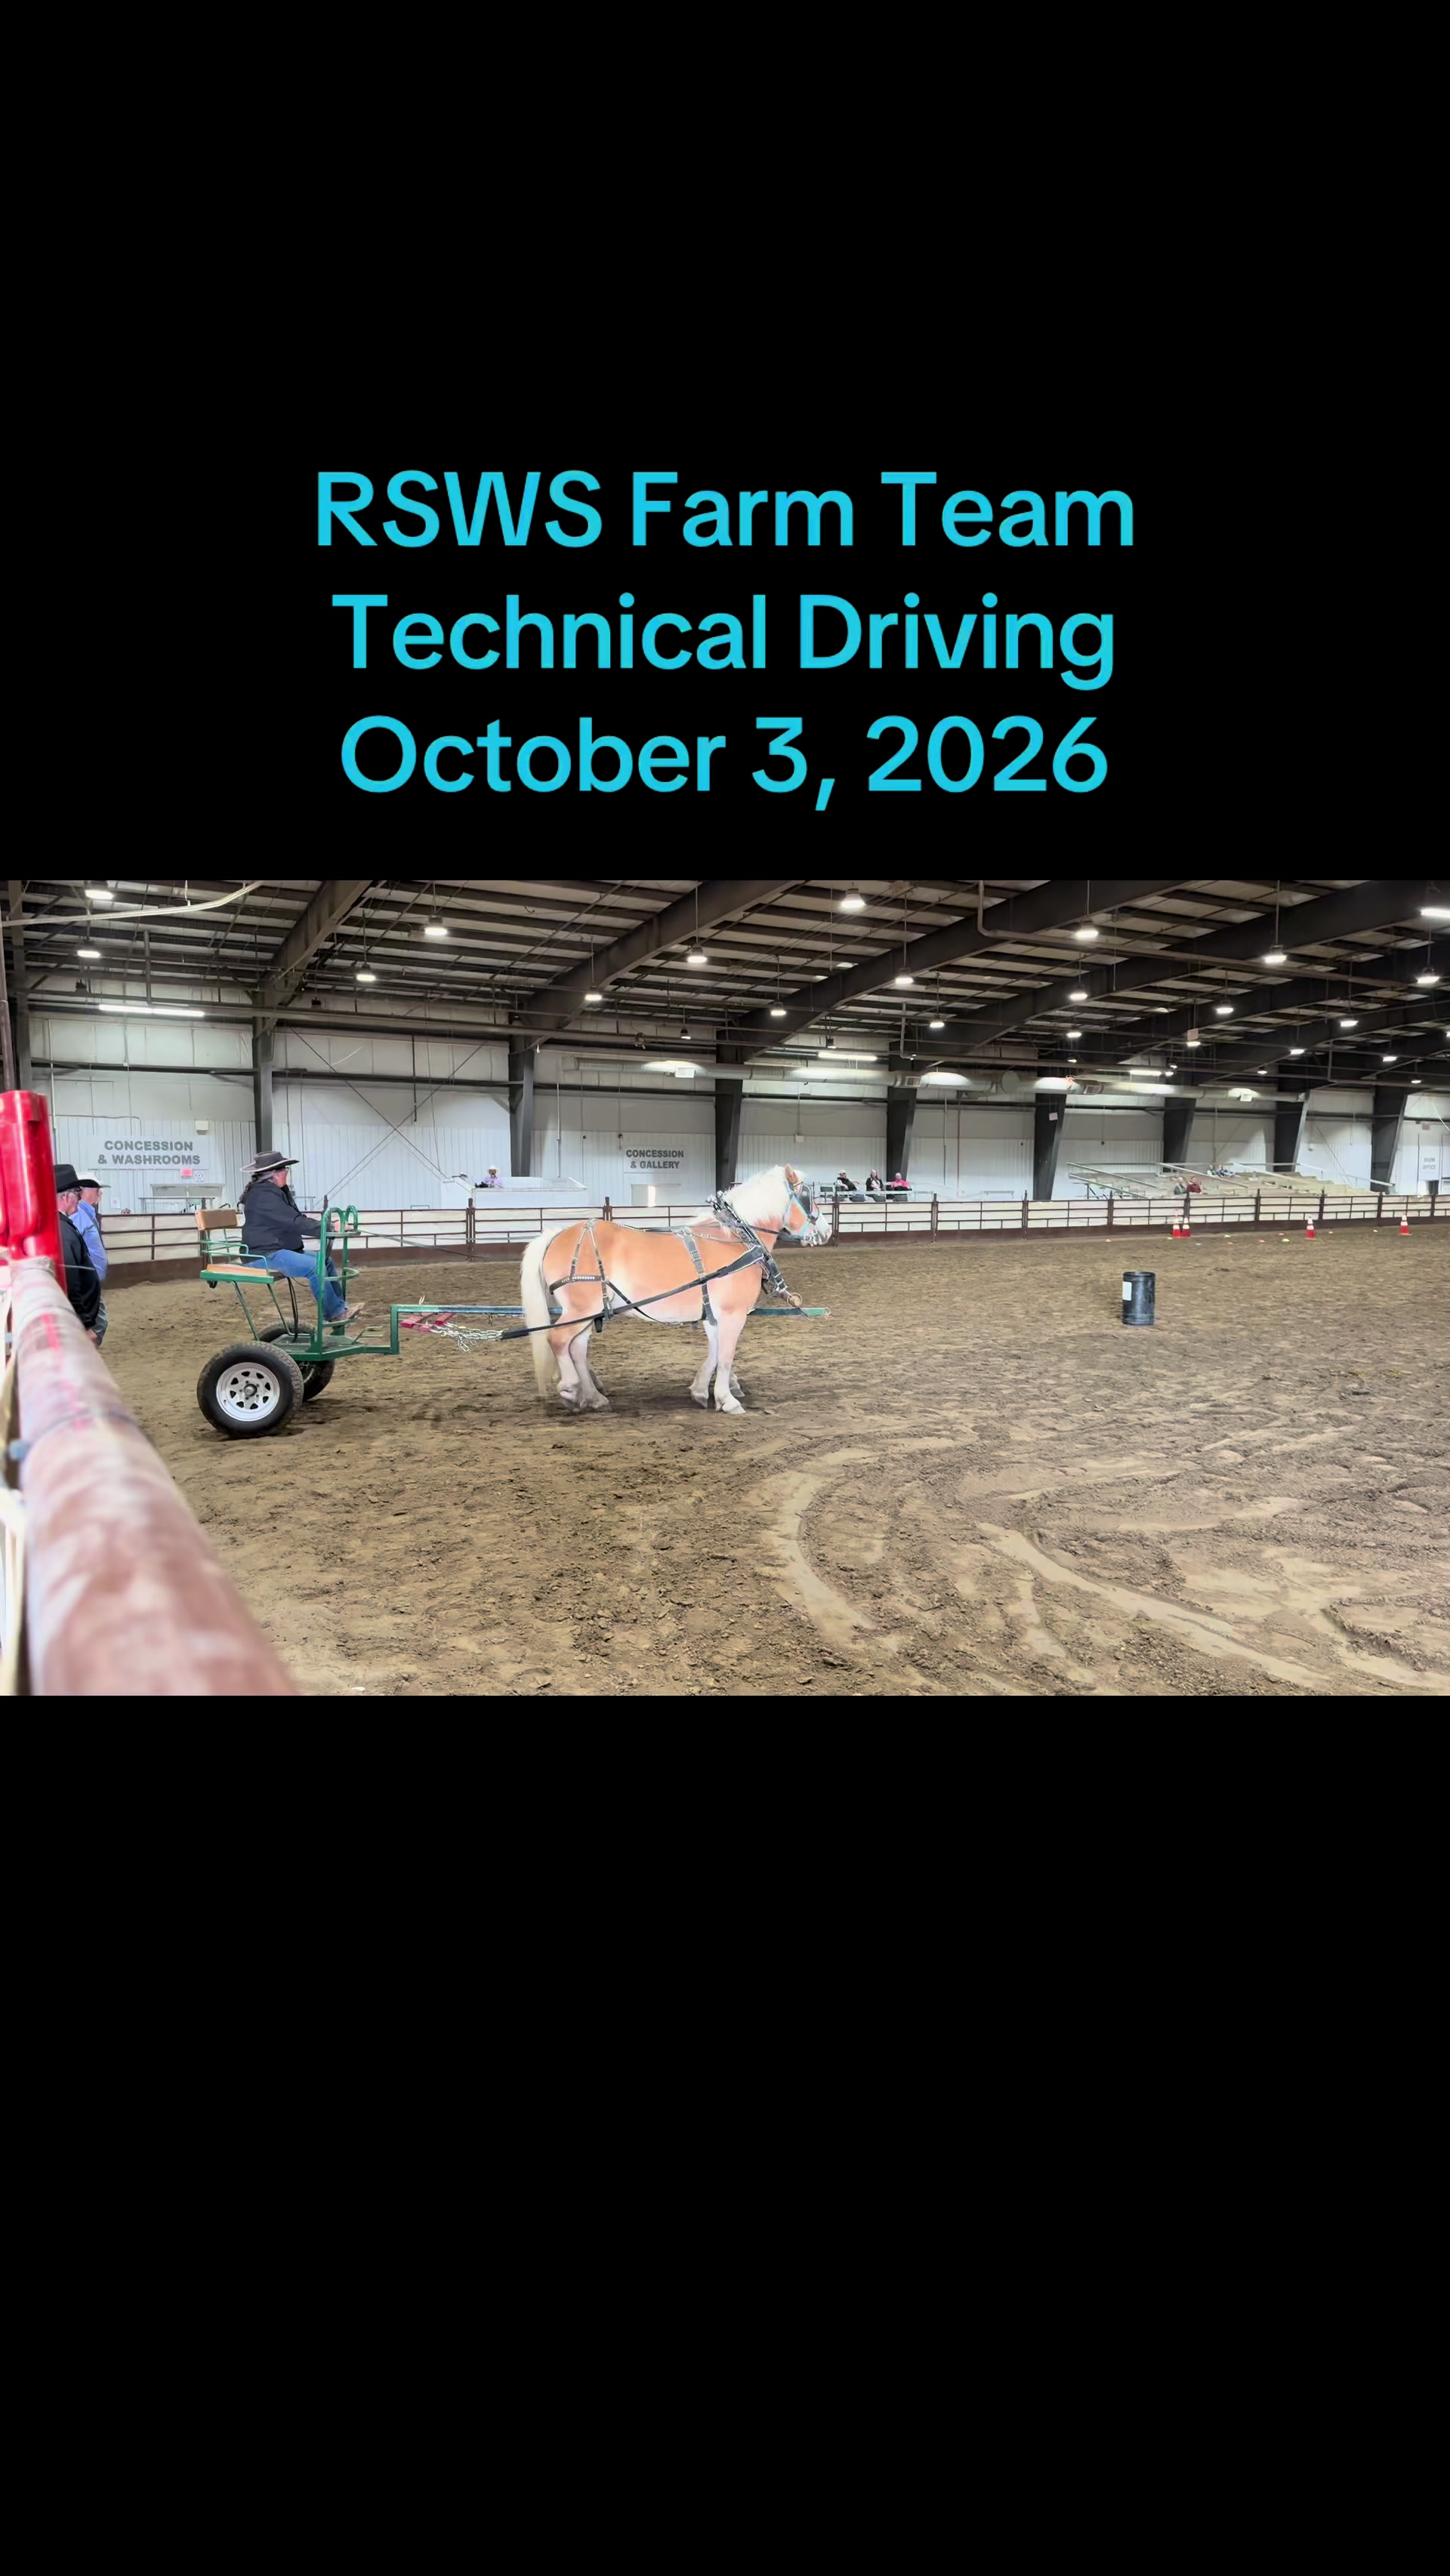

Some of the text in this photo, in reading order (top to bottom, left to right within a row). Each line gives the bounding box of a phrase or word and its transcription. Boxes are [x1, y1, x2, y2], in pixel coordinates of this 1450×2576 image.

[104, 1141, 193, 1151] CONCESSION
[626, 1149, 684, 1157] CONCESSION
[97, 1154, 200, 1164] & WASHROOMS
[630, 1160, 680, 1169] & GALLERY
